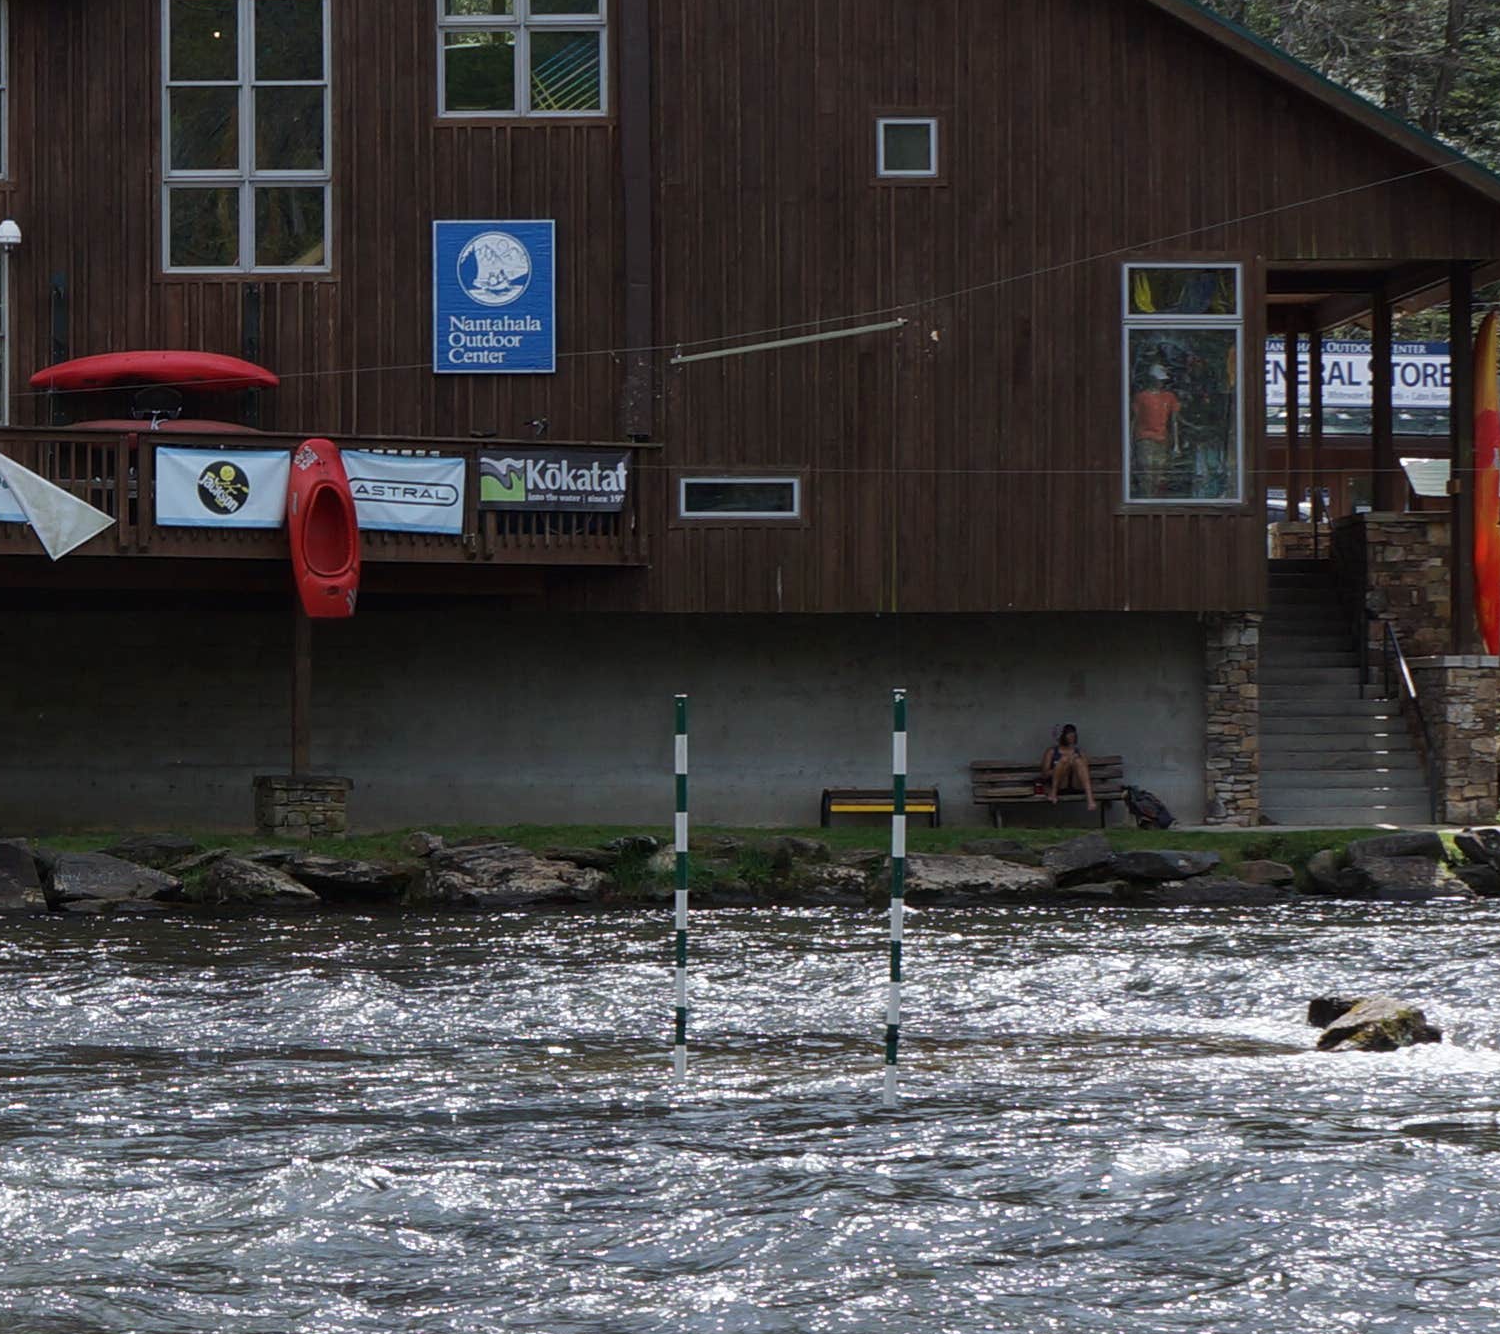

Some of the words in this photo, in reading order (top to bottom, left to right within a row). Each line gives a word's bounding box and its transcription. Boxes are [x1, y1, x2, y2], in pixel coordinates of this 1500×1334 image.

[449, 315, 542, 332] Nantahala
[448, 332, 523, 347] Outdoor
[1326, 341, 1374, 354] OUTDOO
[1392, 344, 1427, 354] ENTER
[448, 348, 506, 364] Center
[1368, 361, 1452, 388] TORE
[198, 470, 240, 512] Jackson
[355, 484, 450, 501] ASTRAL
